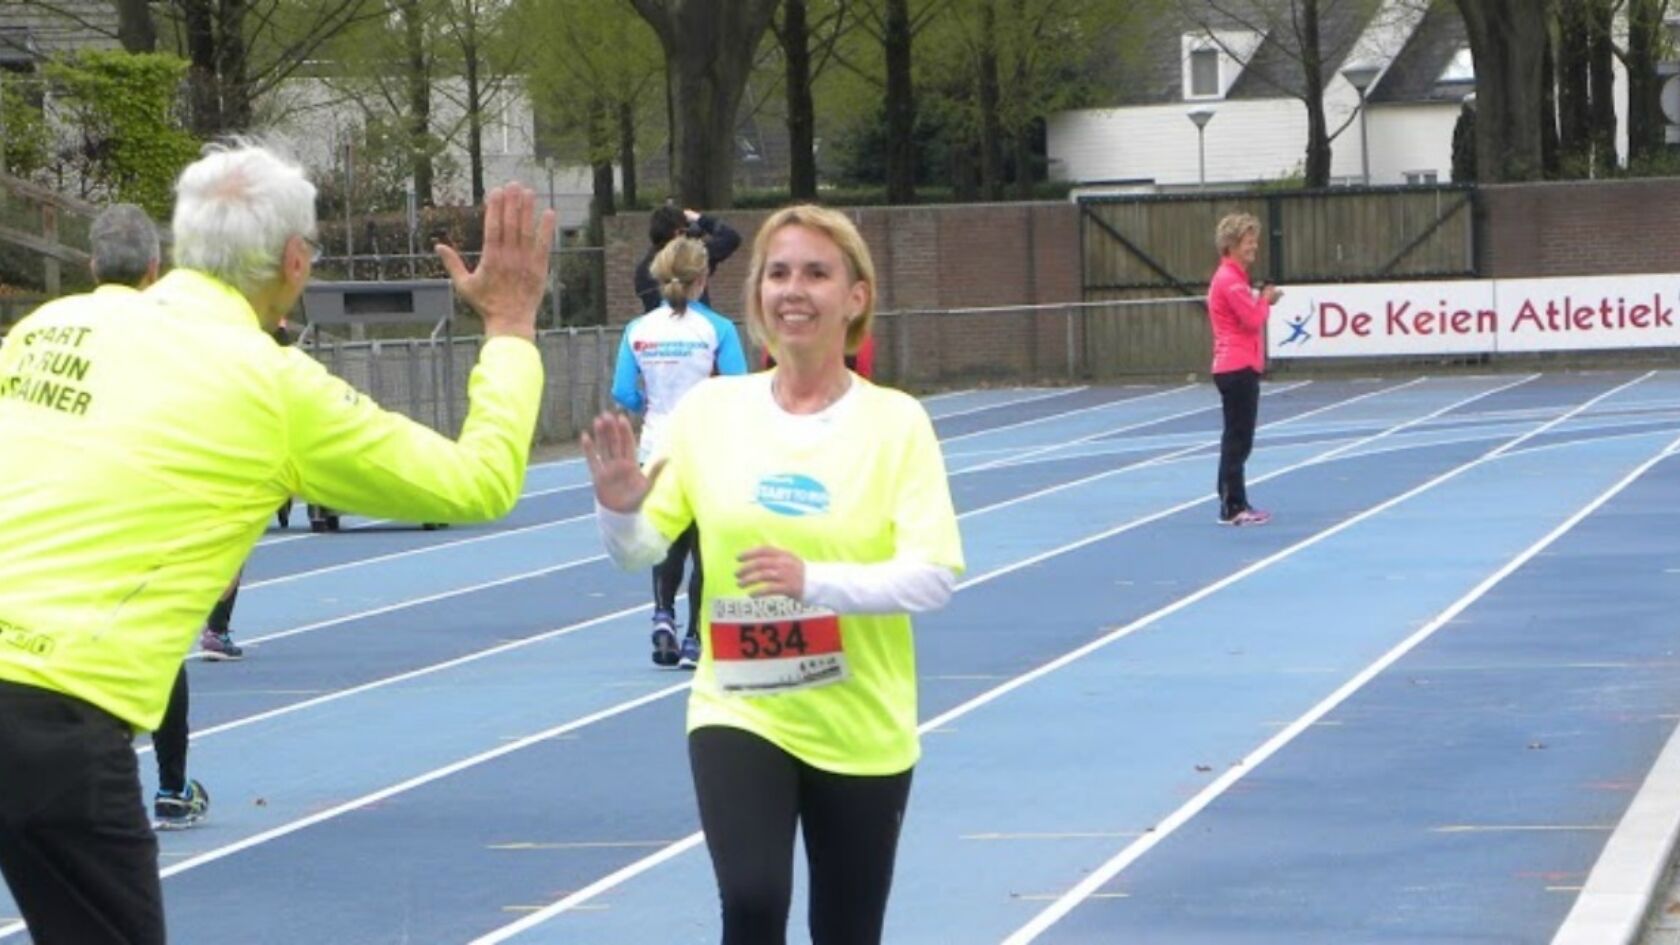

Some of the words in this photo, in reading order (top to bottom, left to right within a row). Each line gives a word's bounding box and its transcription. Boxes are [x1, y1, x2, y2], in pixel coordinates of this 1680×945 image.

[1318, 301, 1372, 338] De
[1385, 300, 1498, 336] Keien
[1511, 293, 1674, 333] Atletiek
[739, 620, 807, 660] 534
